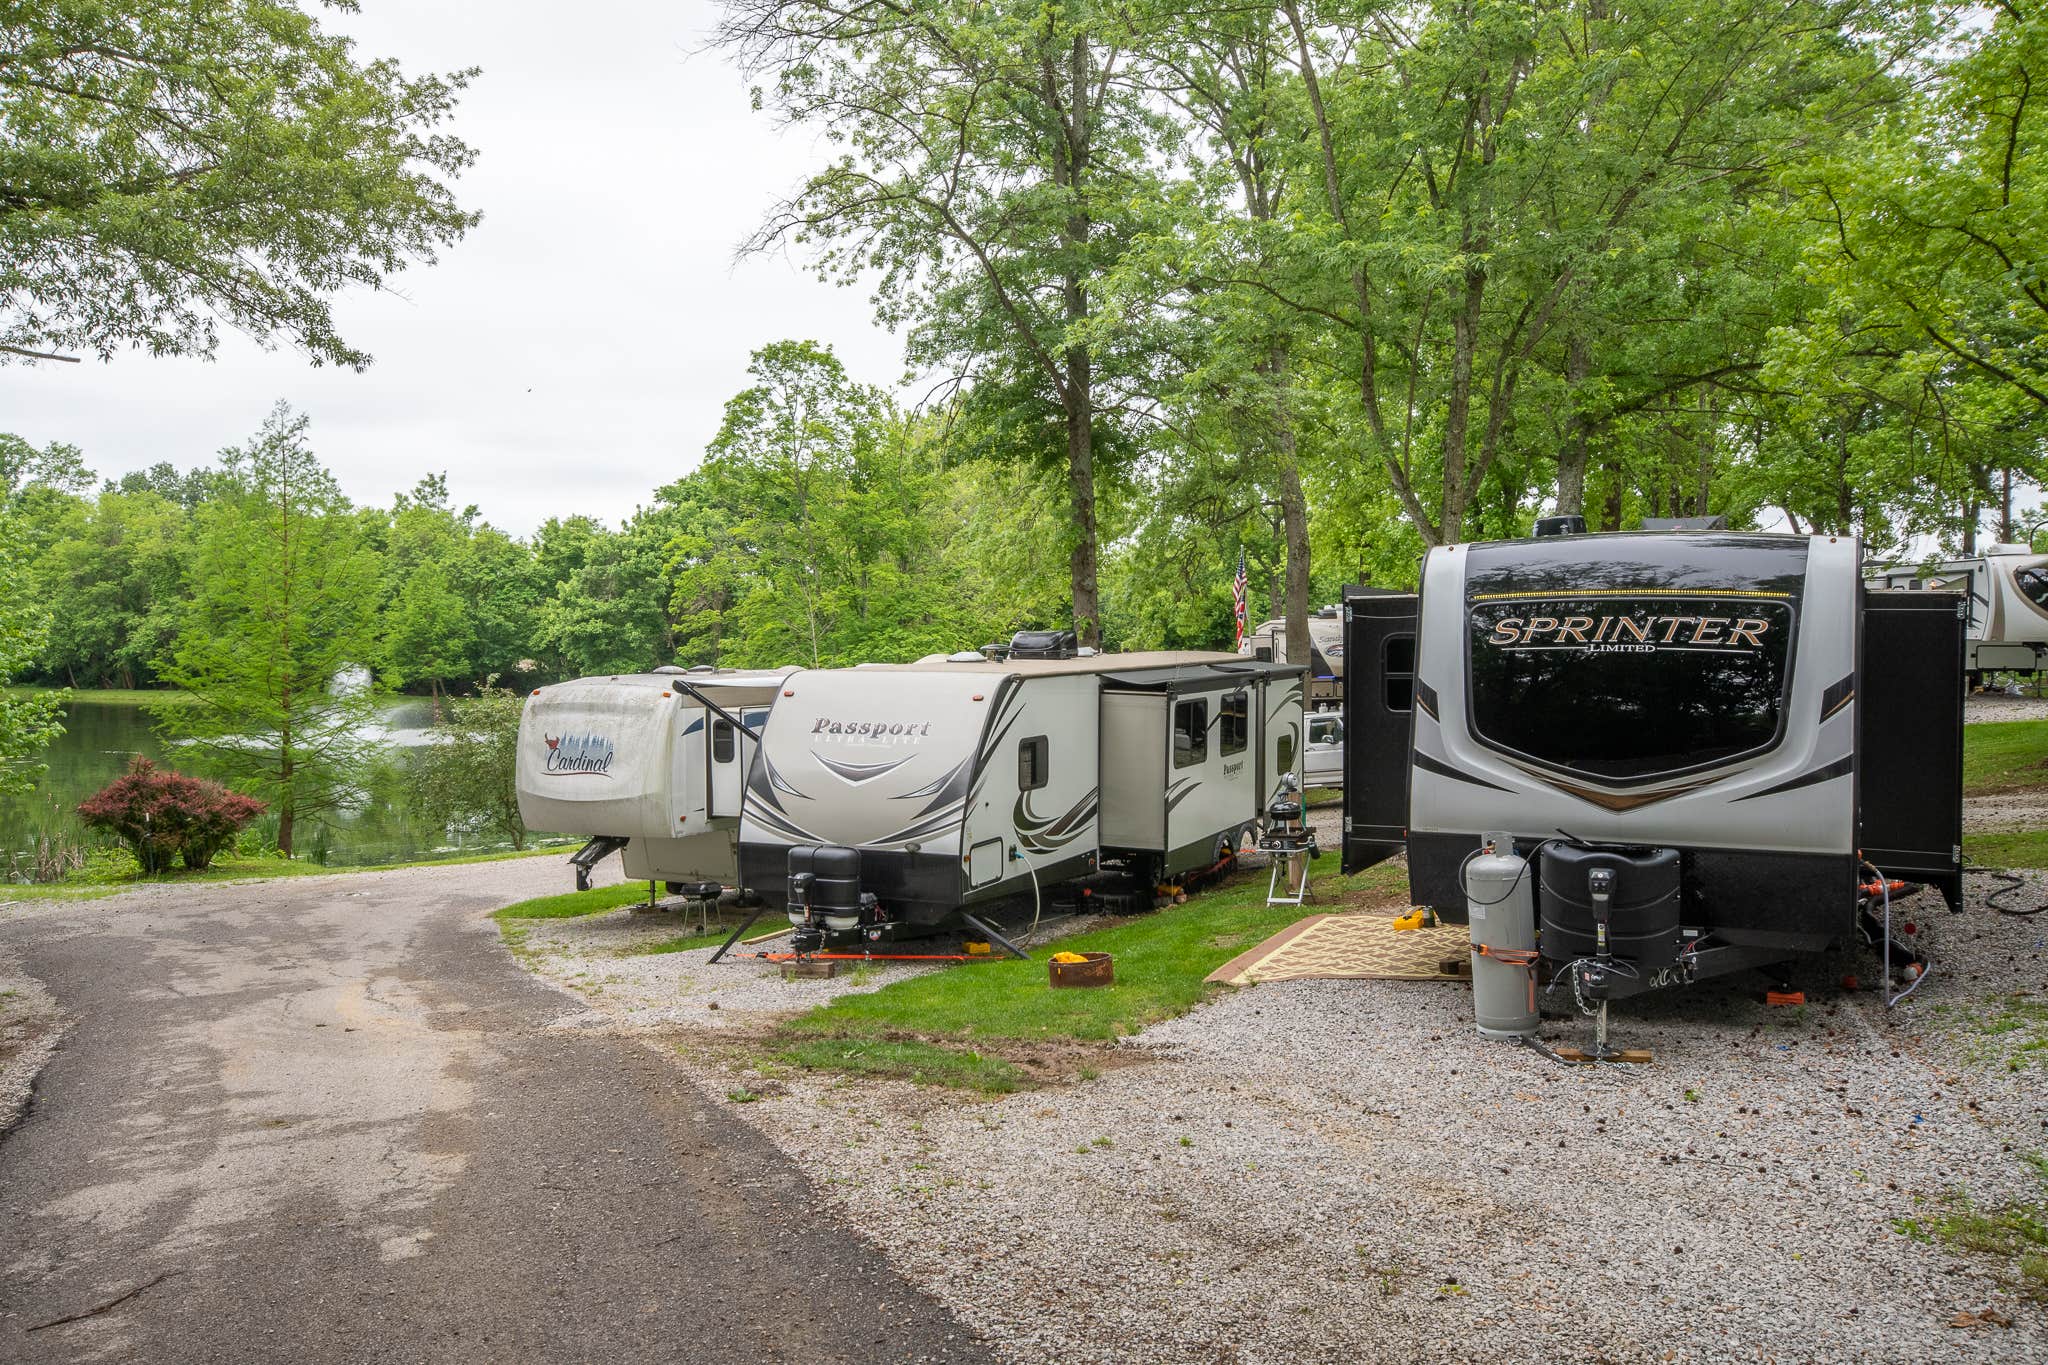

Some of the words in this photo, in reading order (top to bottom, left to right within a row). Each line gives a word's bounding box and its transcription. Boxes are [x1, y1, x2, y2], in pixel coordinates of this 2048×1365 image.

[1489, 616, 1769, 647] SPRINTER
[1590, 643, 1656, 653] LIMITED
[811, 717, 932, 739] Passport
[547, 747, 614, 773] Cardinal
